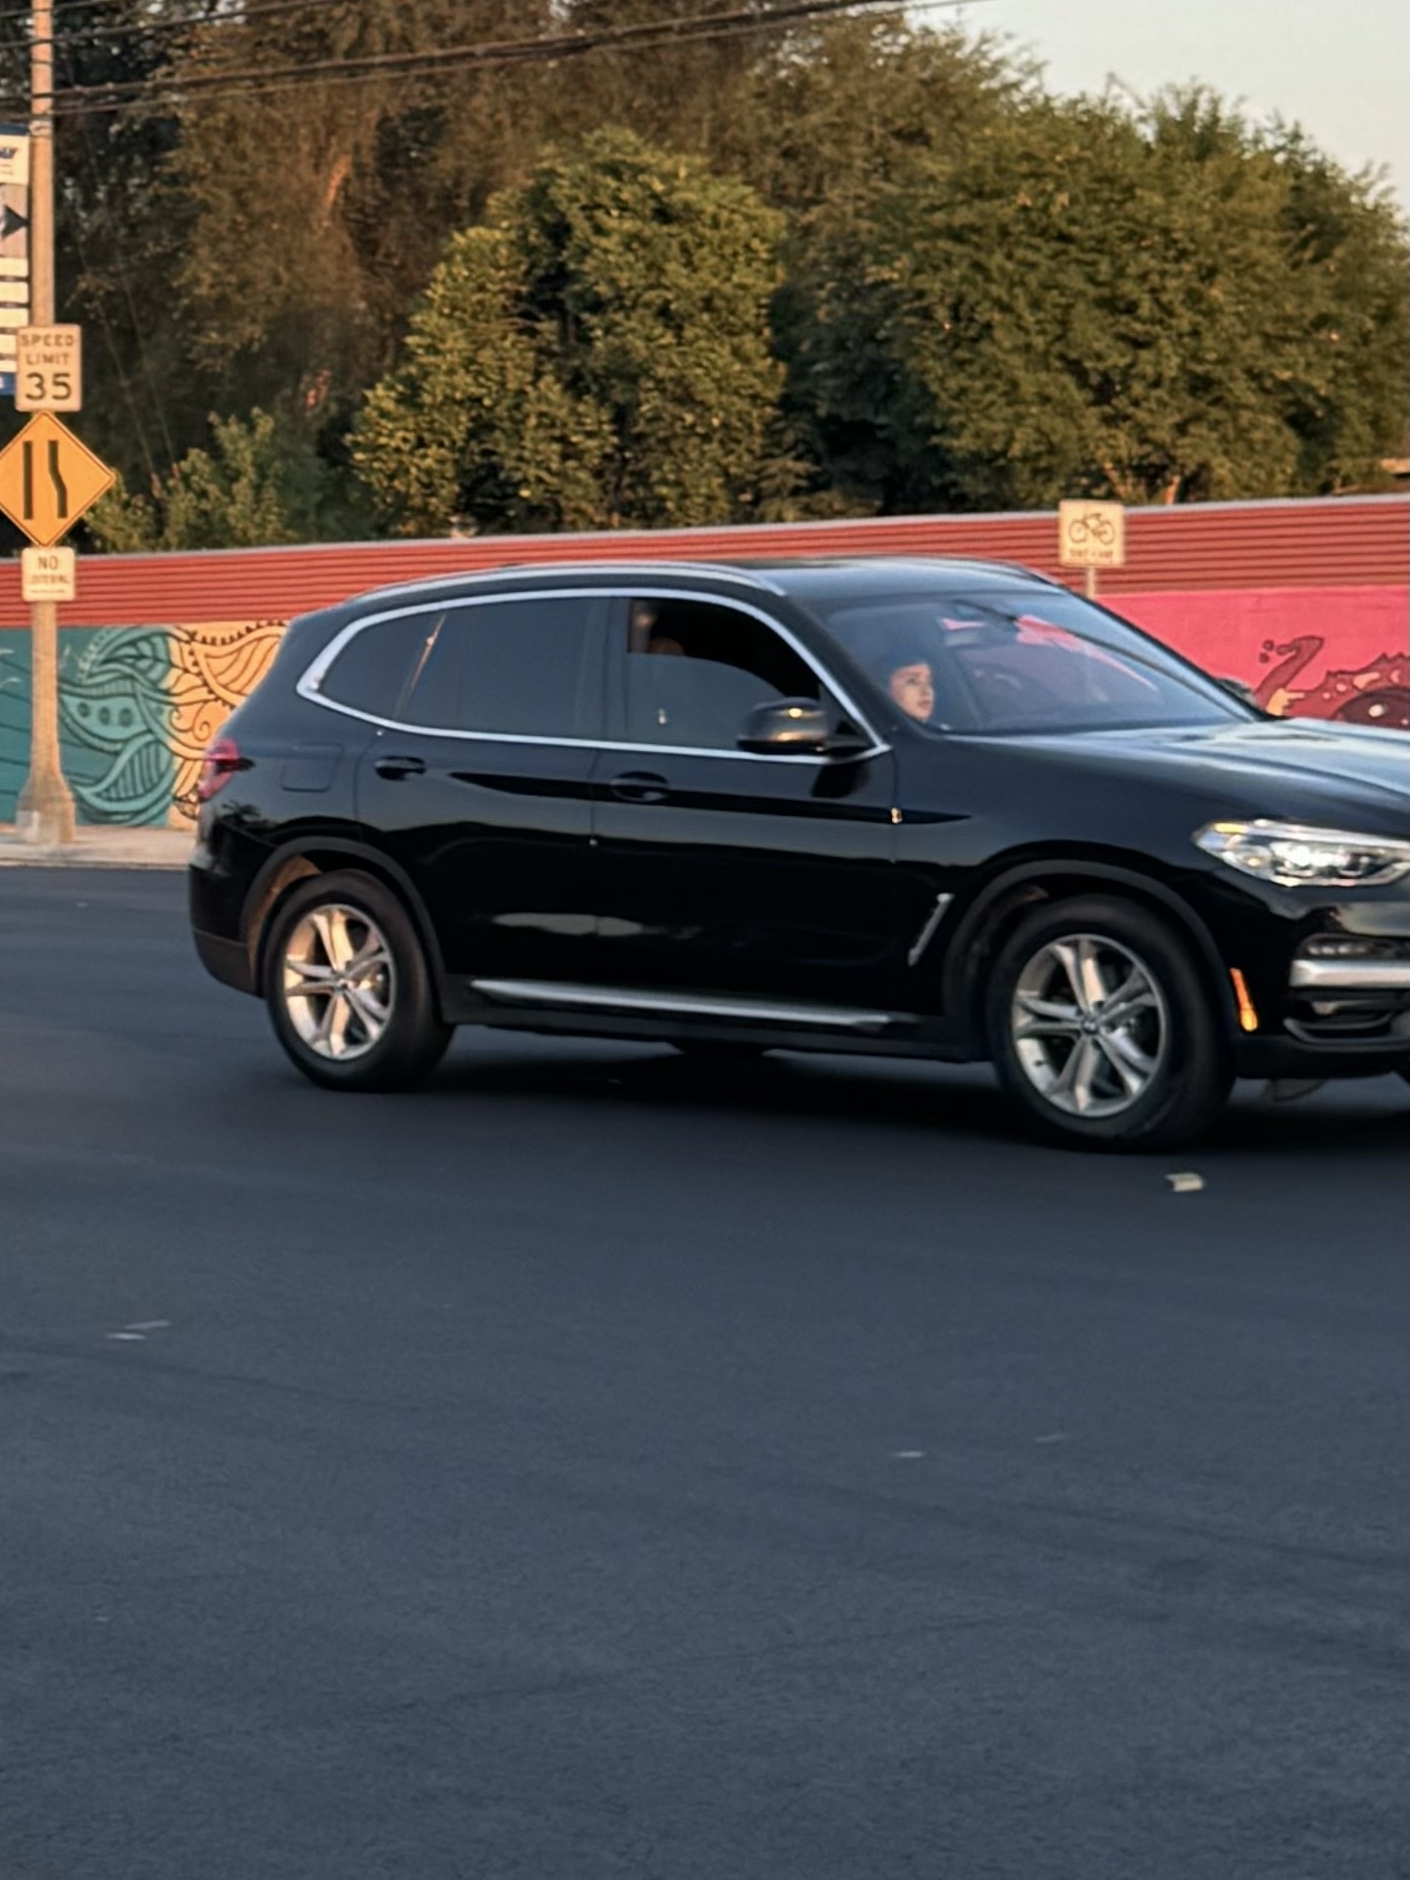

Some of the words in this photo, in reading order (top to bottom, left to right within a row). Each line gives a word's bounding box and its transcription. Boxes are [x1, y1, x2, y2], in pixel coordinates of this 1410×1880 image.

[20, 334, 75, 347] SPEED
[25, 353, 70, 366] LIMIT
[25, 372, 73, 401] 35
[37, 555, 59, 571] NO
